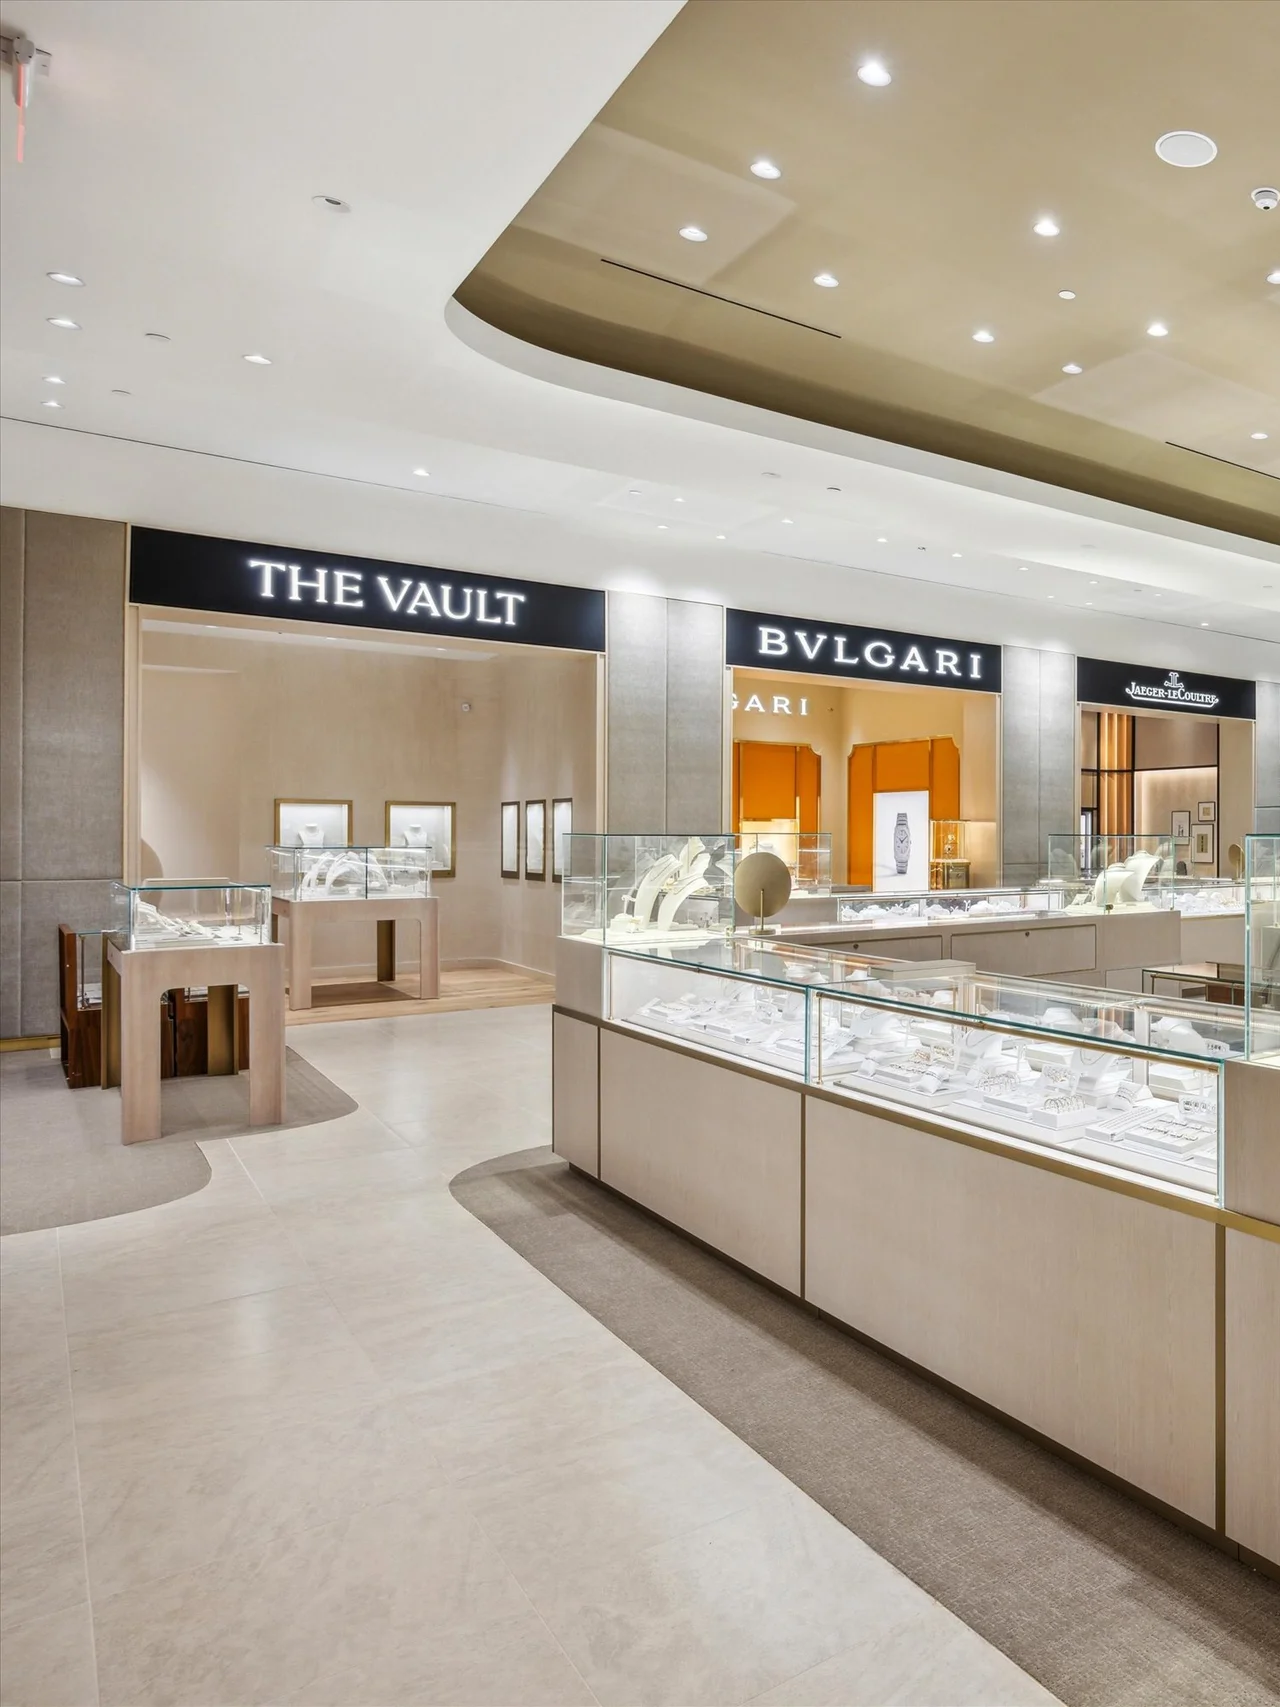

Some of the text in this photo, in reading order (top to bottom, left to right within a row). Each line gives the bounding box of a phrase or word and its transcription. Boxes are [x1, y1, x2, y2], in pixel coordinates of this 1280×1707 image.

[248, 559, 526, 626] THE VAULT
[758, 626, 982, 679] BVLGARI
